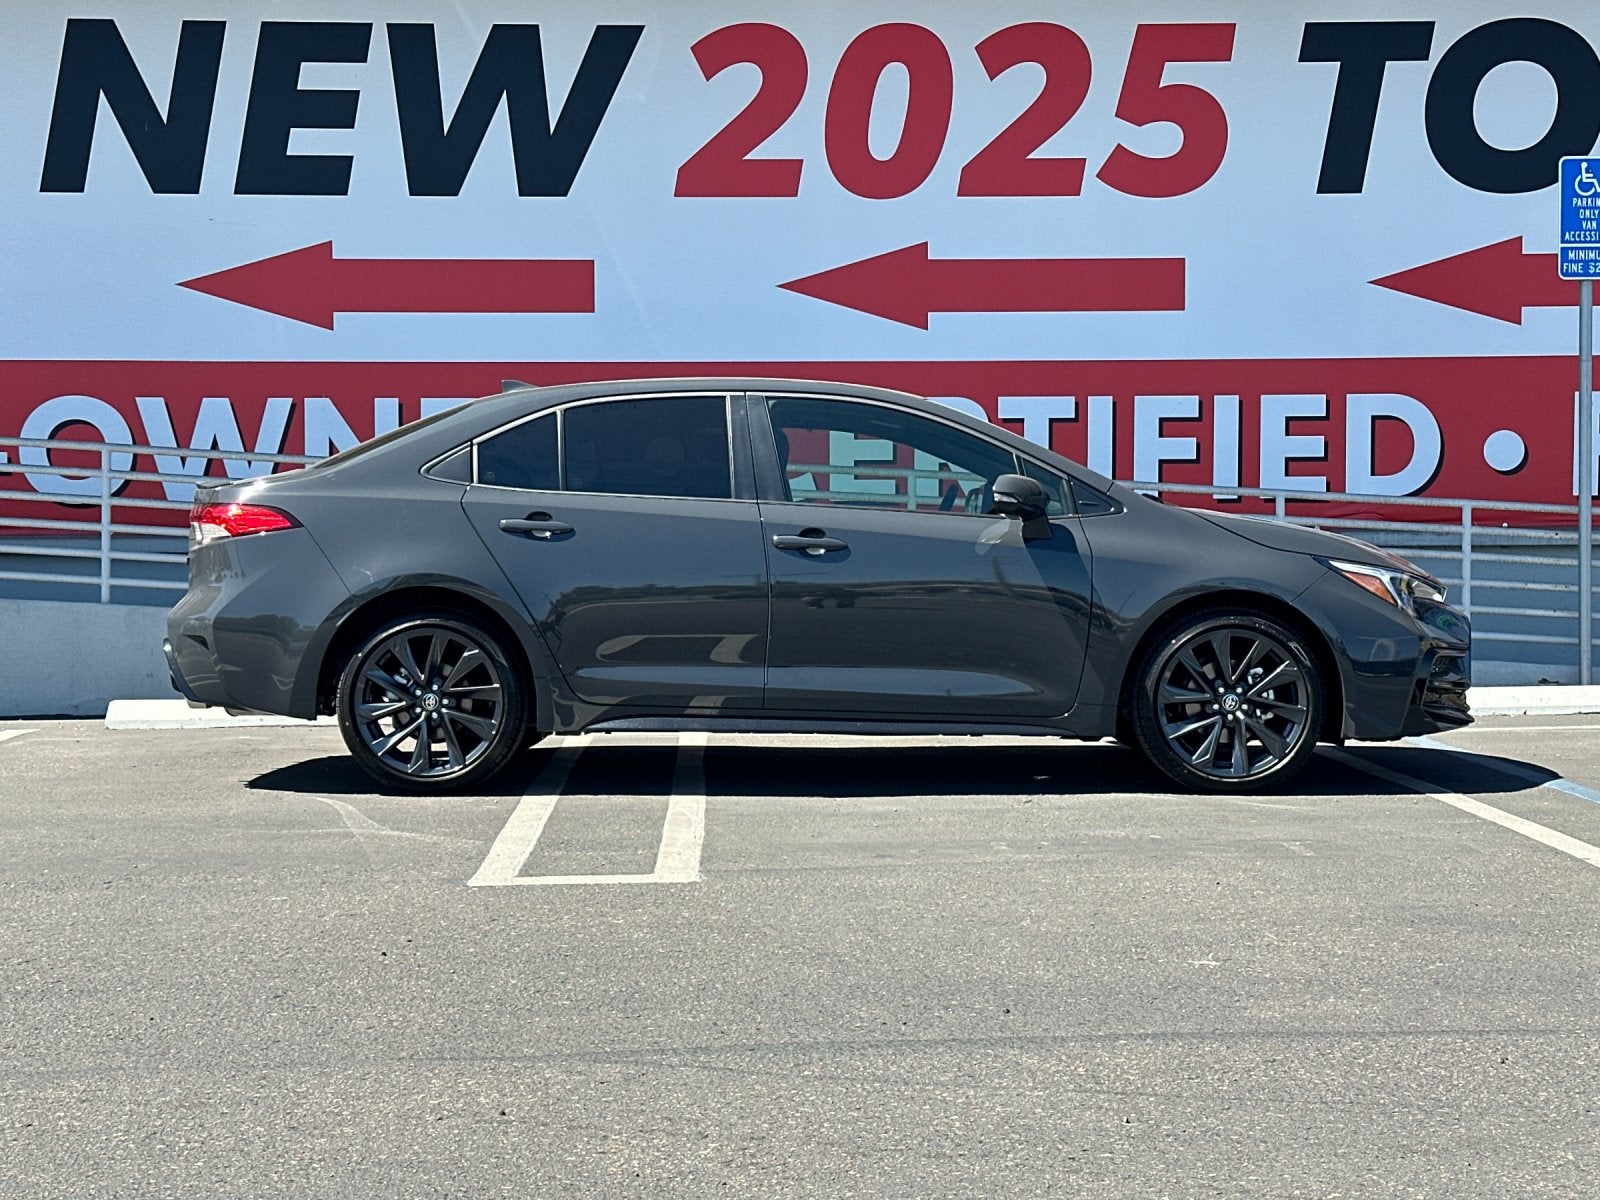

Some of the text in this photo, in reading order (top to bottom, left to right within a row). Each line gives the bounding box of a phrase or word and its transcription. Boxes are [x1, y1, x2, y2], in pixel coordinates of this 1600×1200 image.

[39, 16, 1600, 200] NEW 2025 TO
[1579, 208, 1599, 219] ONLY
[1582, 220, 1597, 230] VAN
[1563, 262, 1584, 273] FINE
